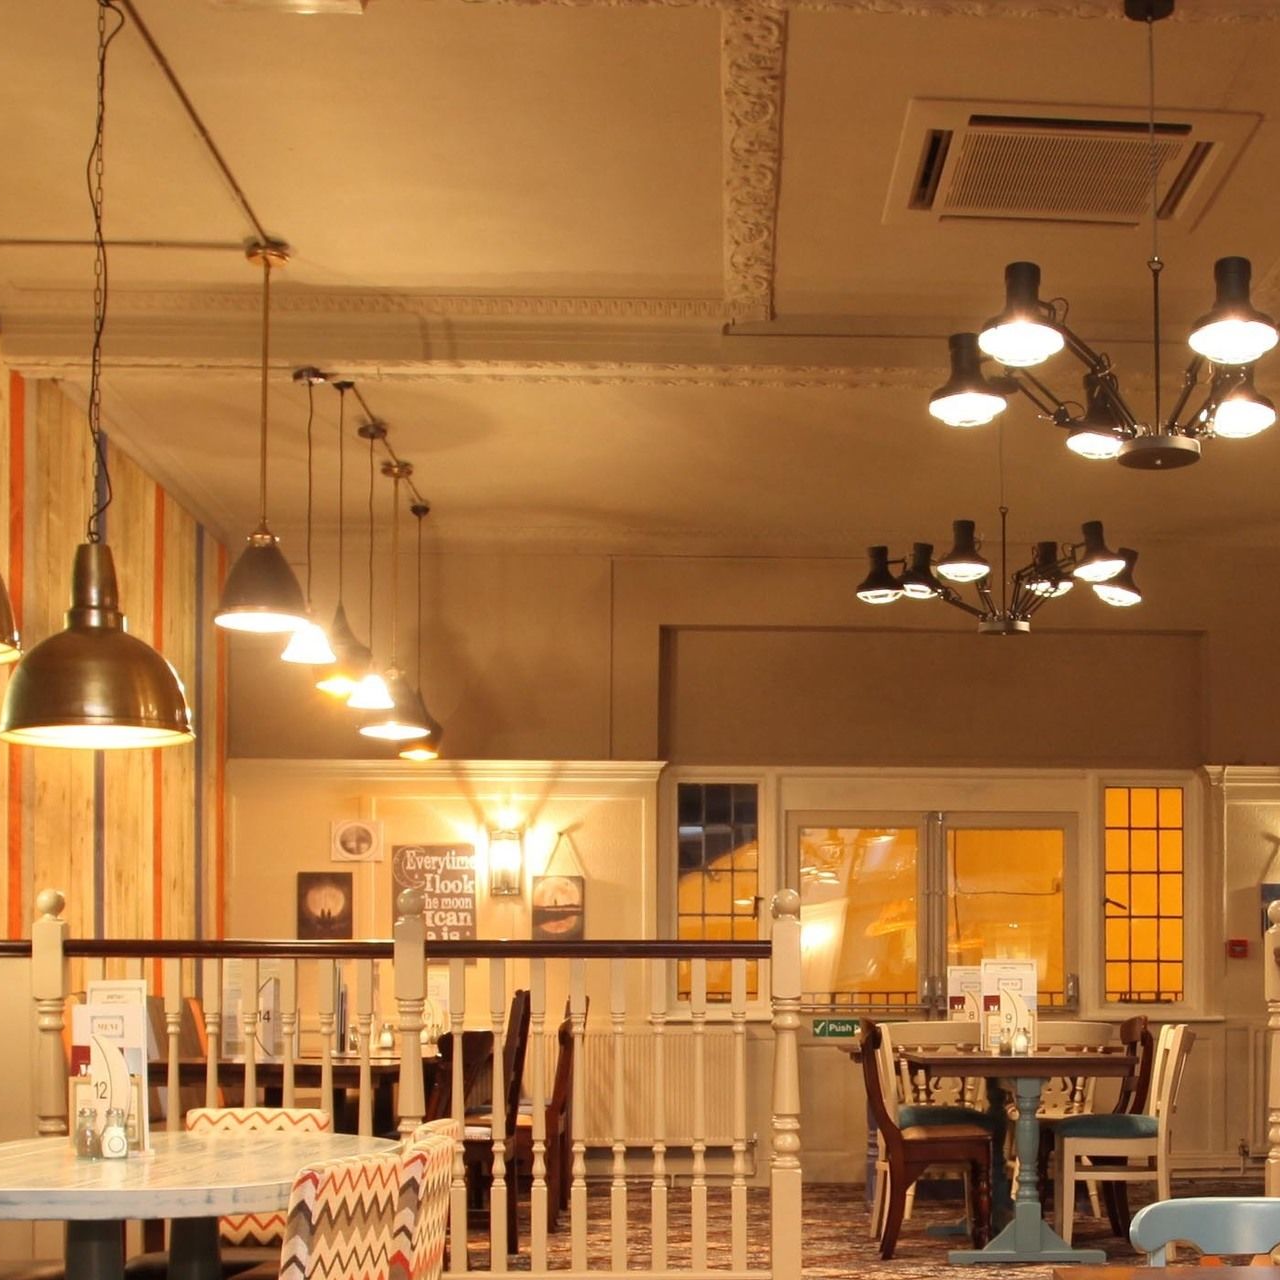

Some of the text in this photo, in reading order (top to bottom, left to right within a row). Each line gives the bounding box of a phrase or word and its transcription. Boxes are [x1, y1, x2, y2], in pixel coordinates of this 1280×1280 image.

[424, 873, 474, 894] I look
[440, 897, 472, 909] moon
[434, 910, 472, 927] can
[258, 1010, 271, 1023] 14
[1005, 1013, 1012, 1023] 9
[829, 1024, 852, 1032] Push
[94, 1081, 108, 1099] 12
